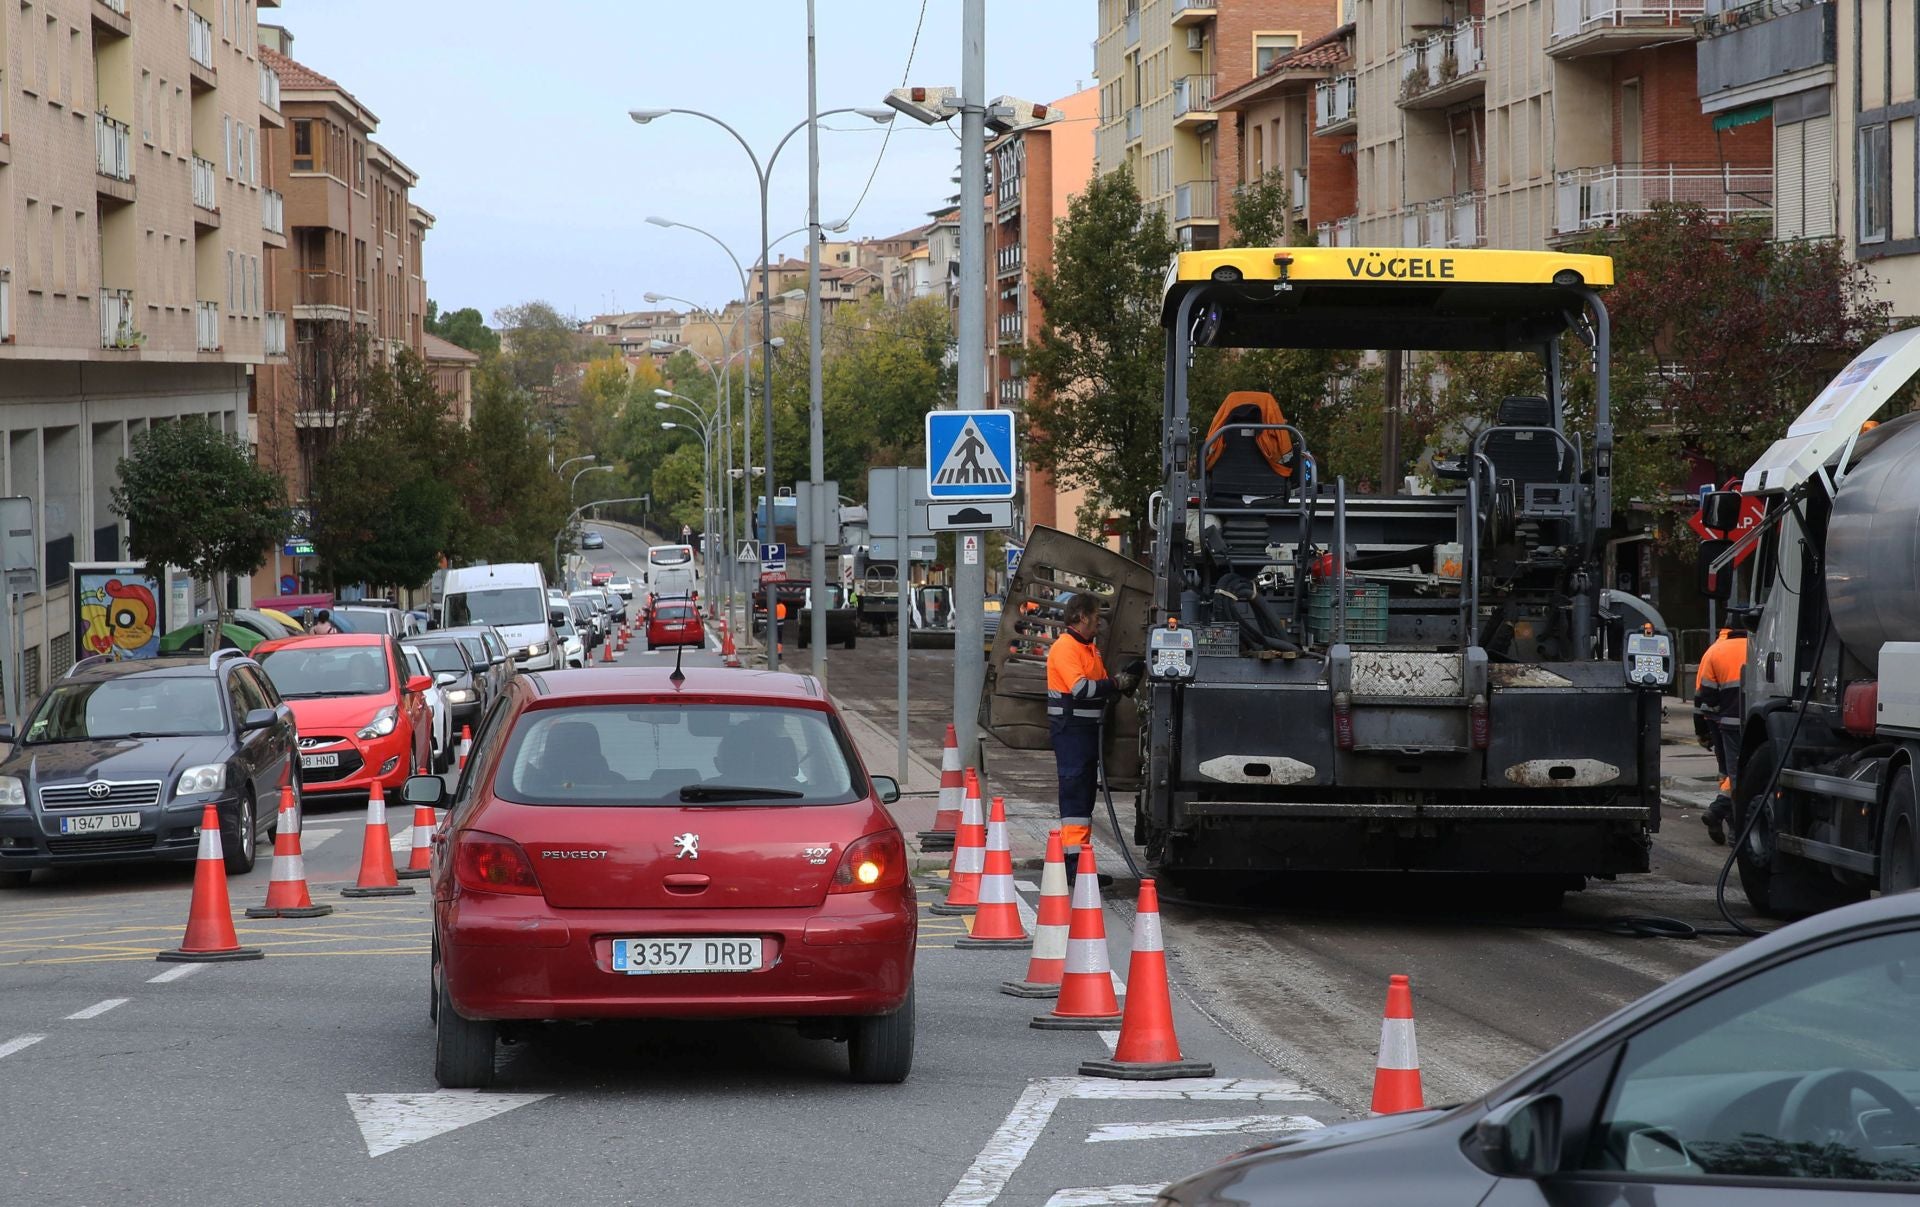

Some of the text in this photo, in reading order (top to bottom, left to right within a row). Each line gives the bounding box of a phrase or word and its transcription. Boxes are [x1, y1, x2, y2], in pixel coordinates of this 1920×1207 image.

[1346, 252, 1455, 278] VÖGELE
[768, 544, 779, 560] P
[316, 755, 336, 766] HND
[72, 814, 137, 831] 1947 DVL
[541, 850, 608, 860] PEUGEOT
[802, 847, 833, 858] 307
[632, 942, 692, 966] 3357
[705, 942, 753, 966] DRB
